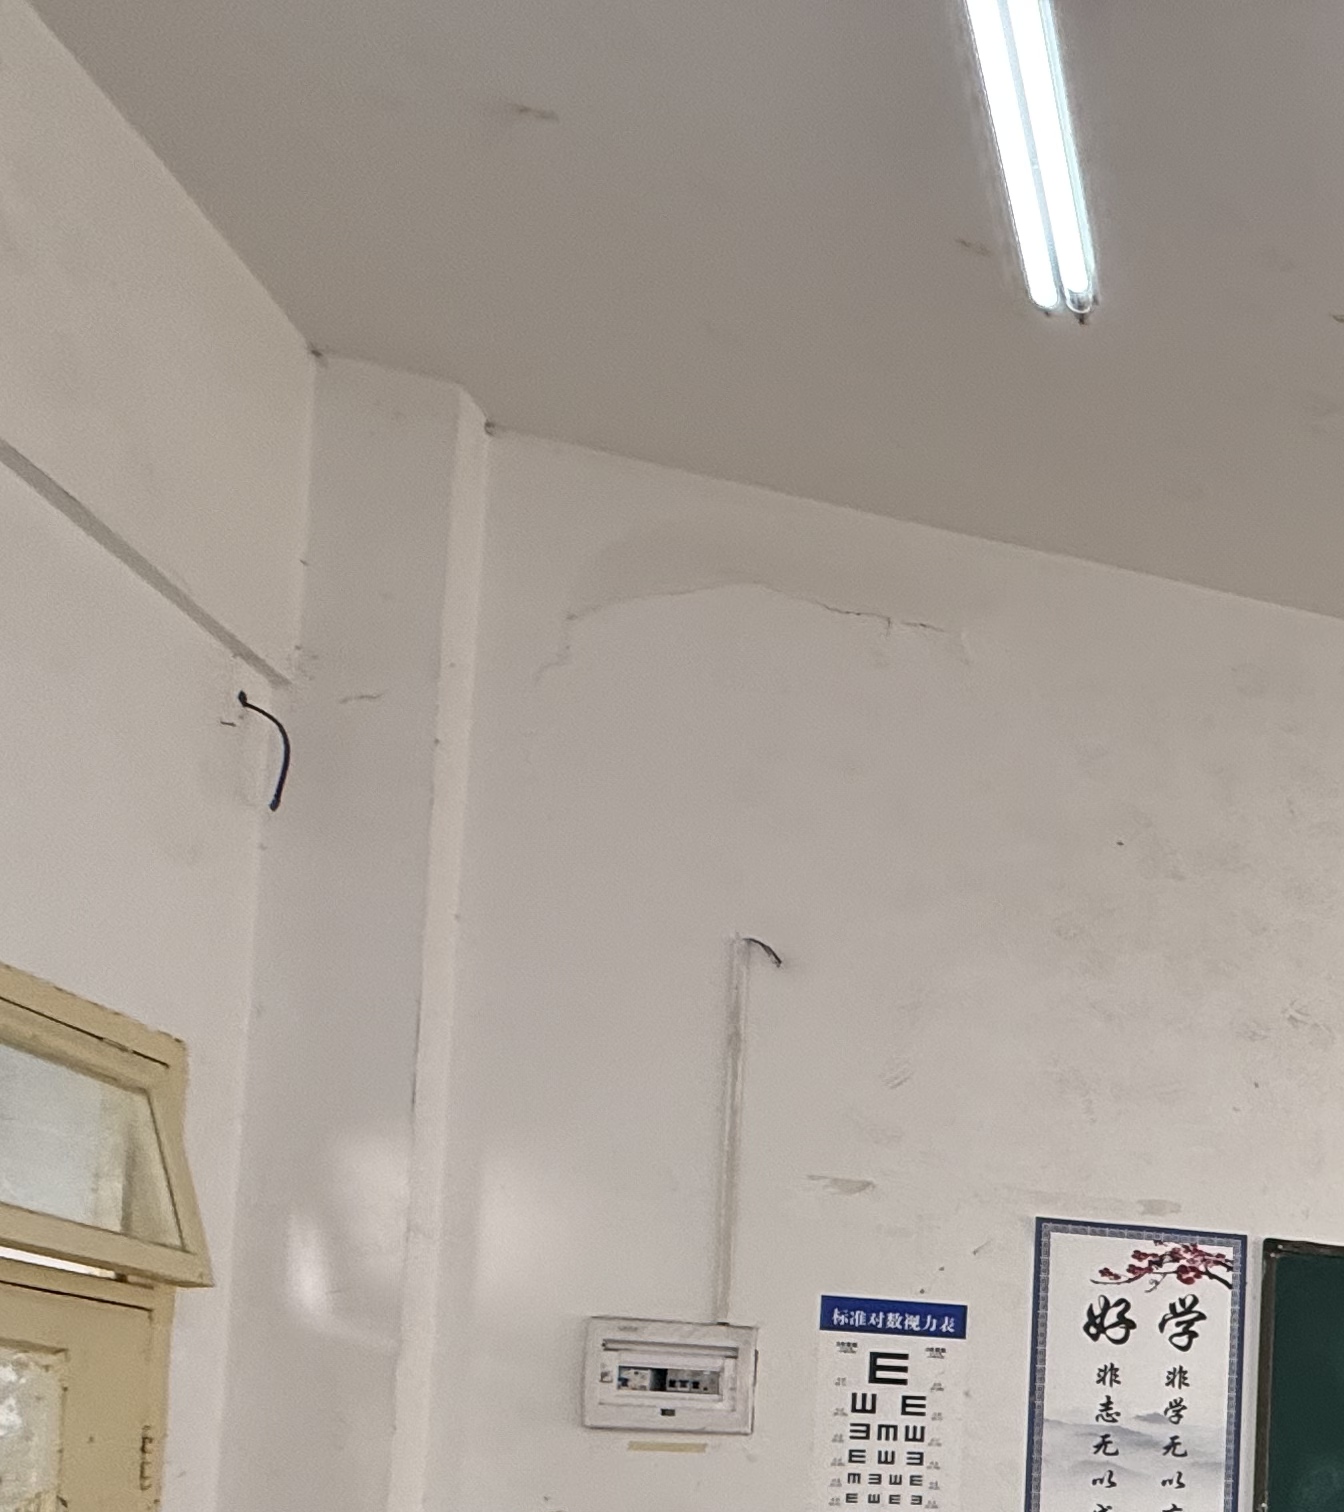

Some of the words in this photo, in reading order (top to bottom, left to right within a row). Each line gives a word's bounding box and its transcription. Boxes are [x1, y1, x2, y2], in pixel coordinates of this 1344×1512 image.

[831, 1307, 956, 1333] 标准对数视力表
